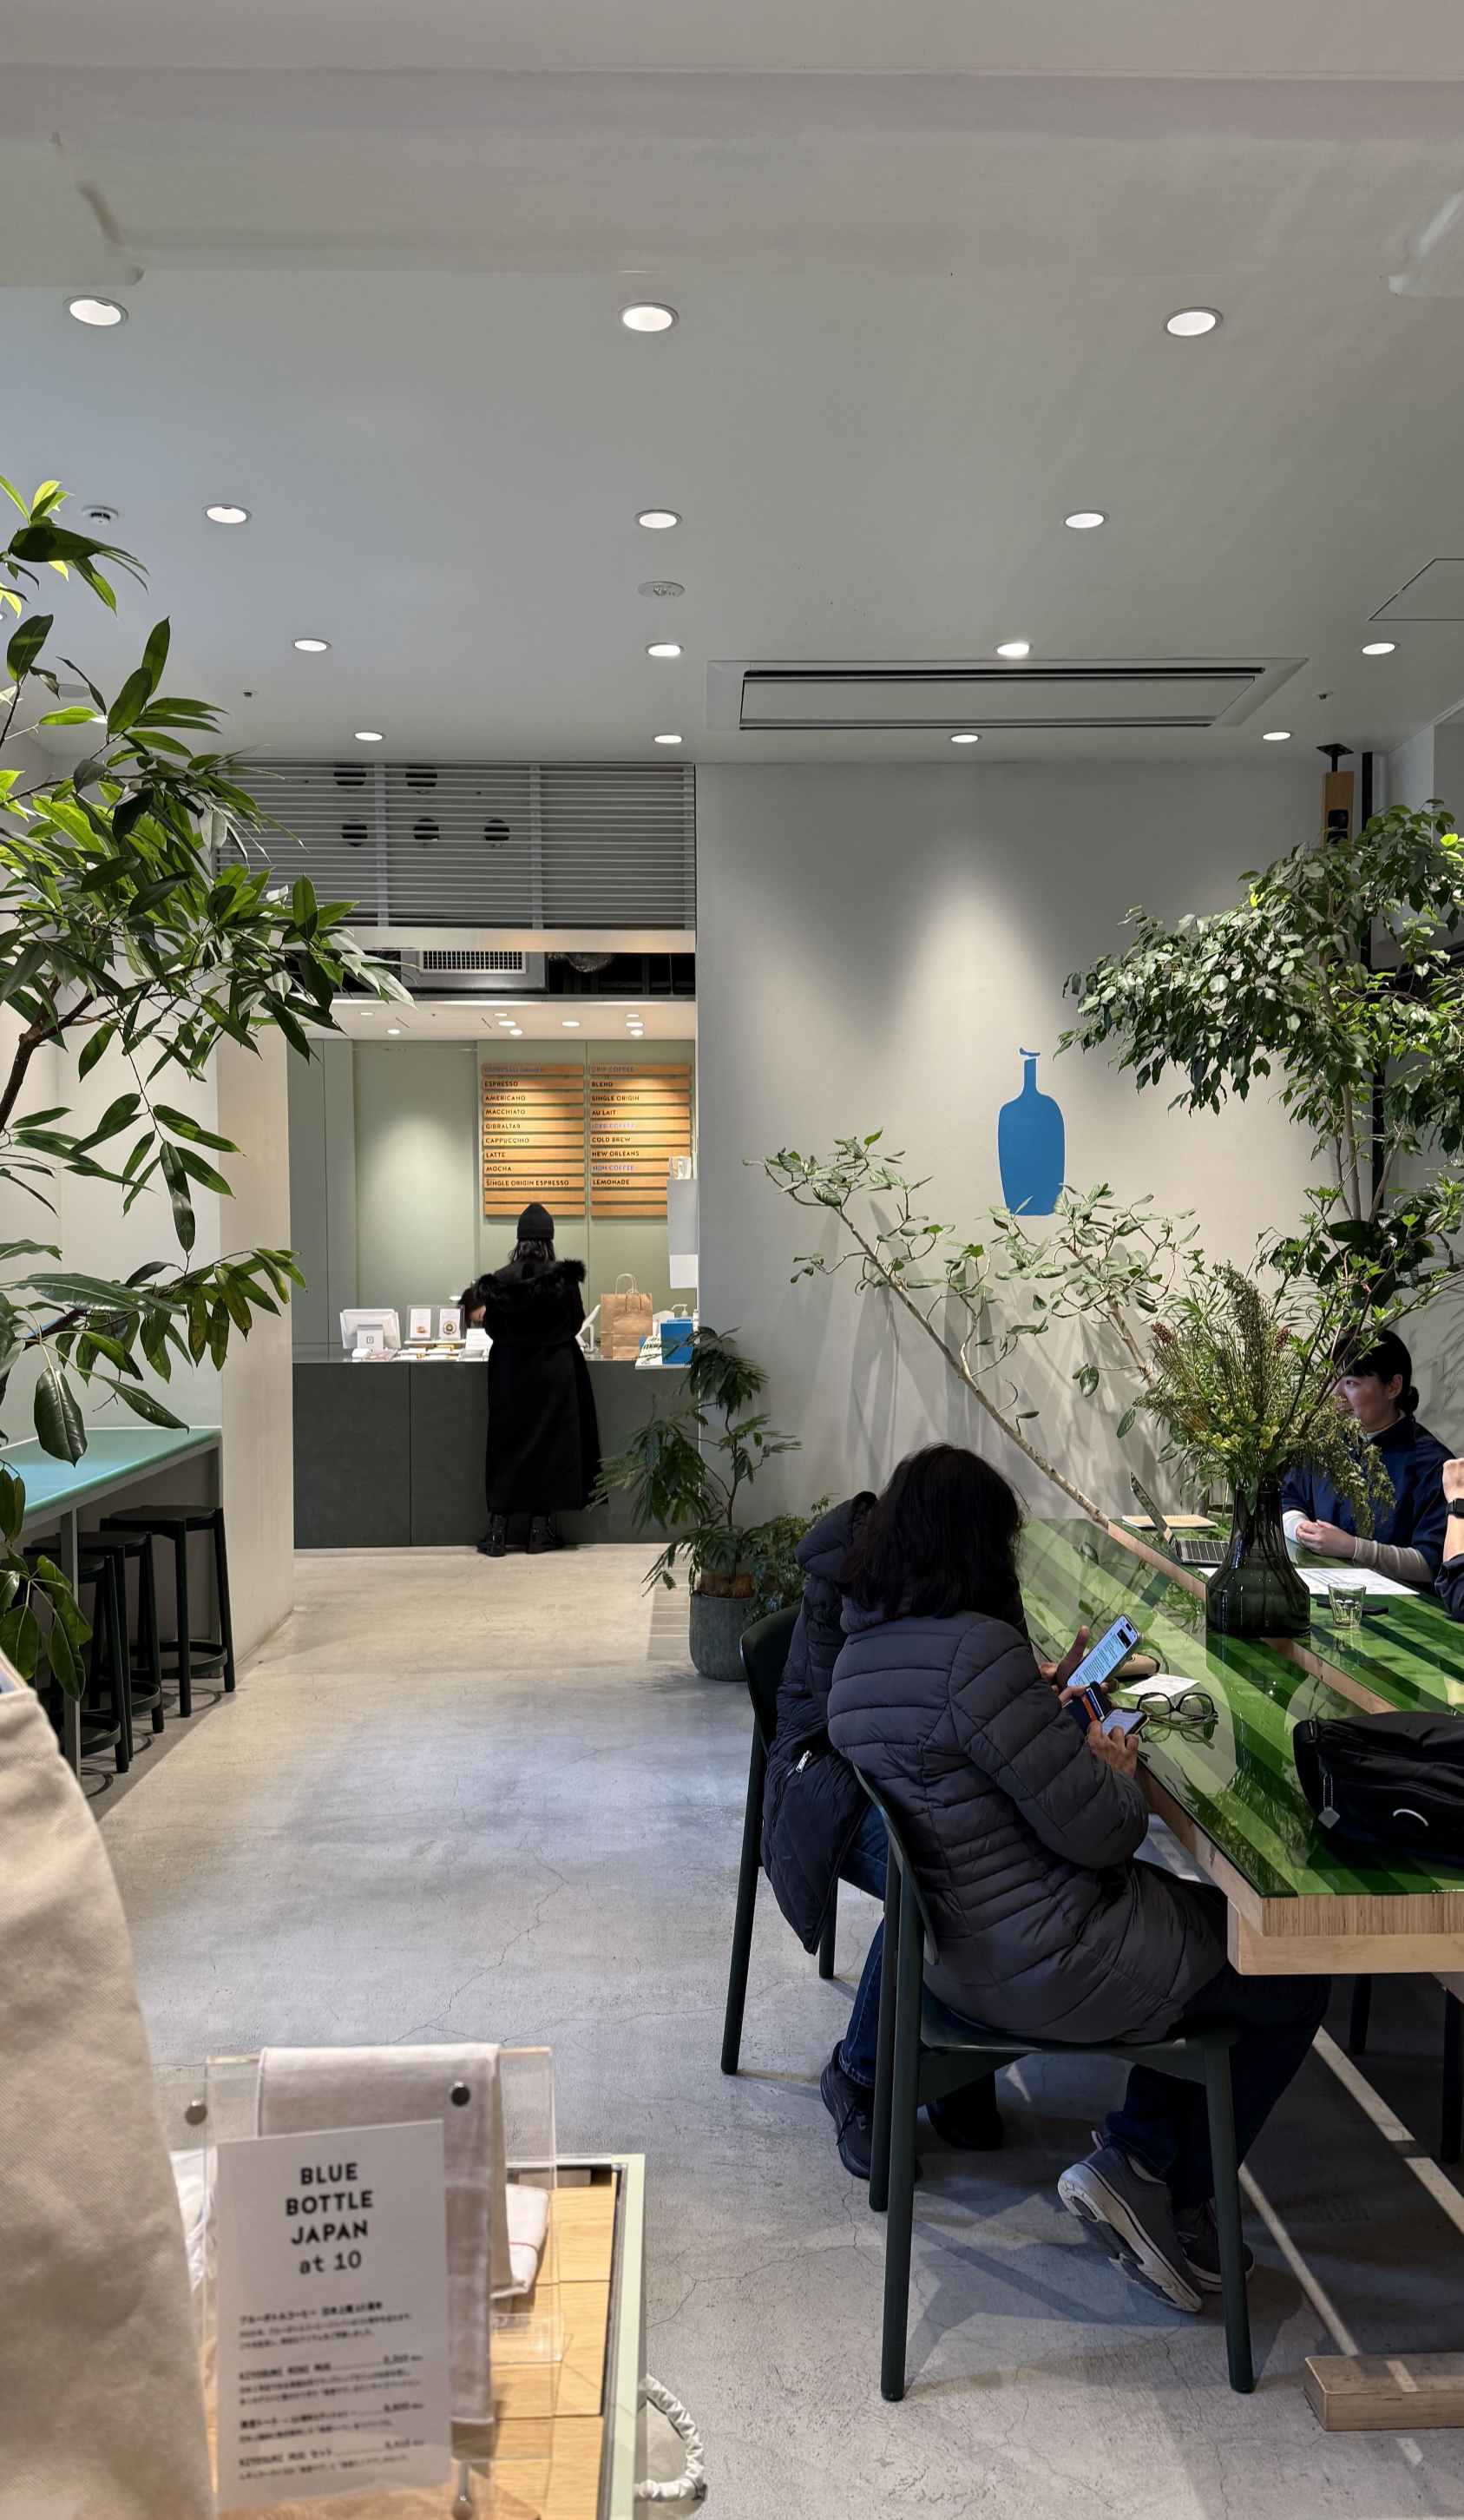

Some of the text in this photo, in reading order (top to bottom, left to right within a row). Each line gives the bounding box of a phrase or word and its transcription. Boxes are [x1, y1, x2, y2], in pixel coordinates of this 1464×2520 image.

[300, 2162, 359, 2186] BLUE
[286, 2189, 374, 2217] BOTTLE
[291, 2220, 369, 2245] JAPAN
[299, 2249, 363, 2275] at 10
